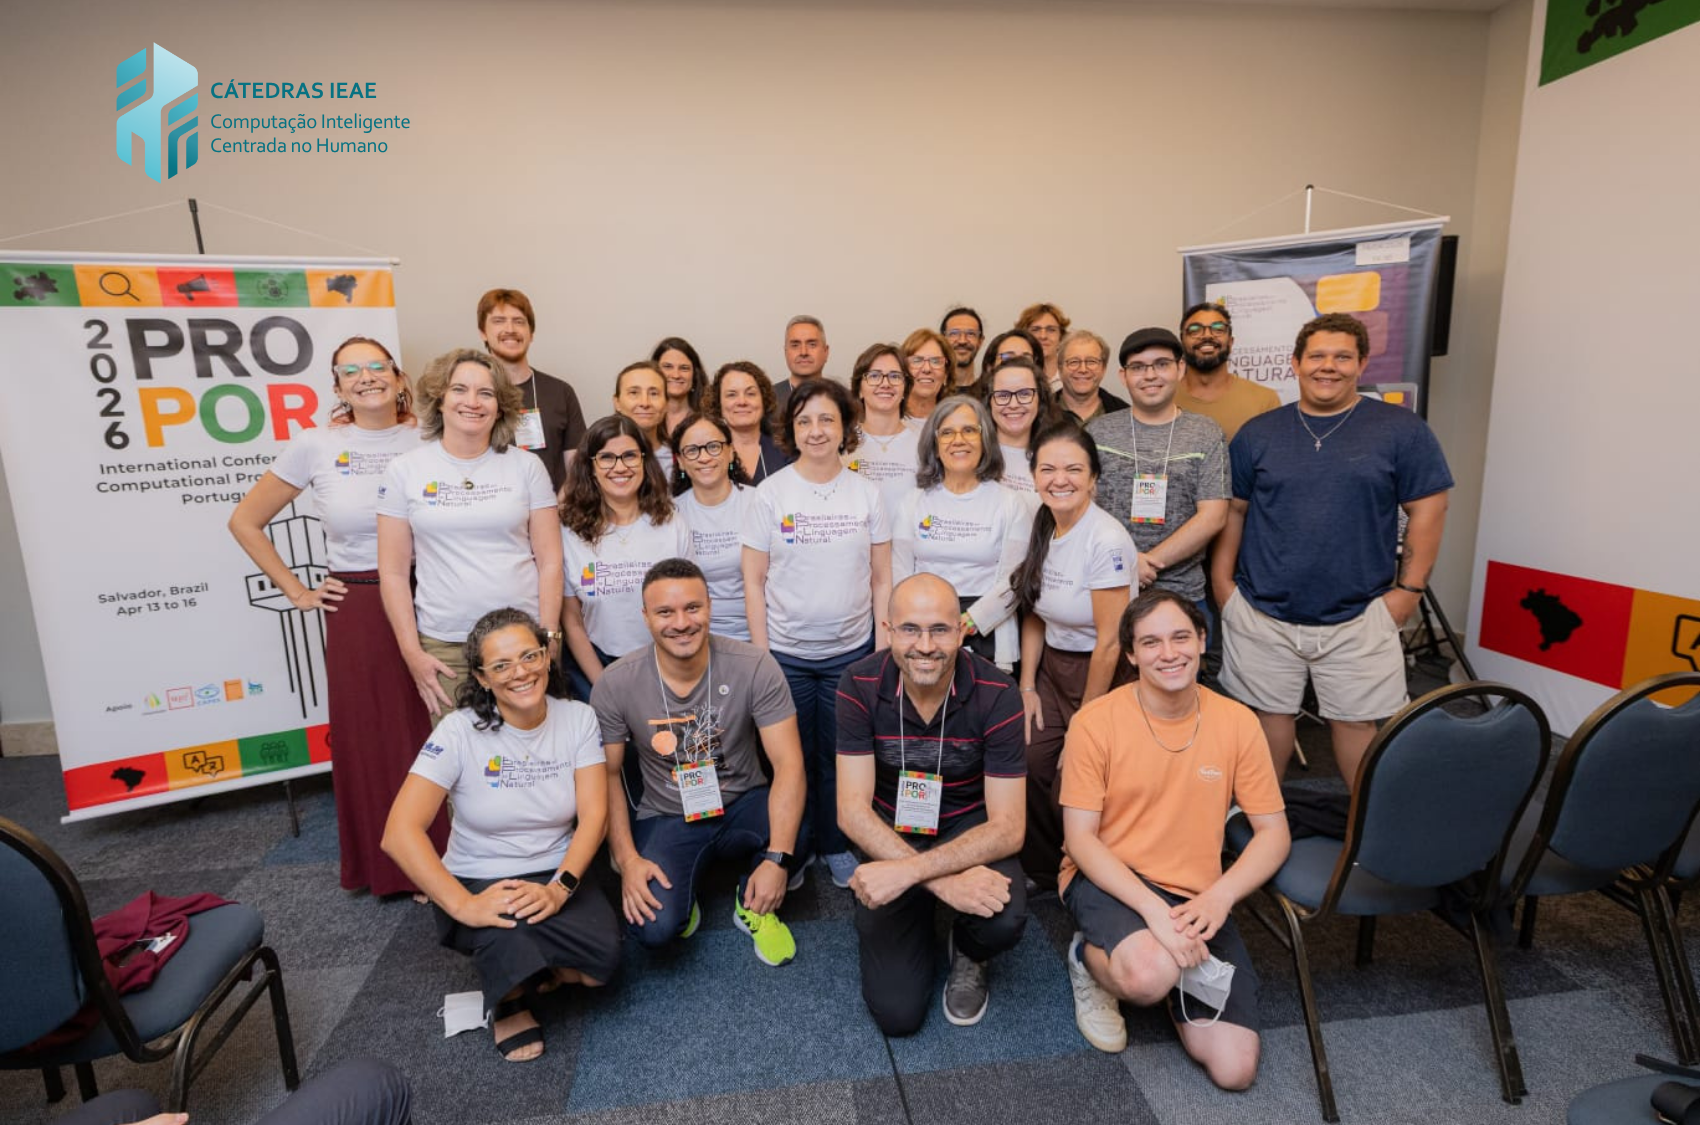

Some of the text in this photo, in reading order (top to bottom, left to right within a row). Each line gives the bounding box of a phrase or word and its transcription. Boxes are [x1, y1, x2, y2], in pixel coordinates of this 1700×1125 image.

[125, 315, 314, 380] PRO
[138, 383, 319, 448] POR
[99, 457, 217, 475] International
[96, 473, 230, 493] Computational
[97, 582, 209, 604] Salvador, Brazil
[117, 597, 197, 616] Apr 13 to 16
[904, 789, 926, 800] POR
[905, 781, 927, 791] PRO
